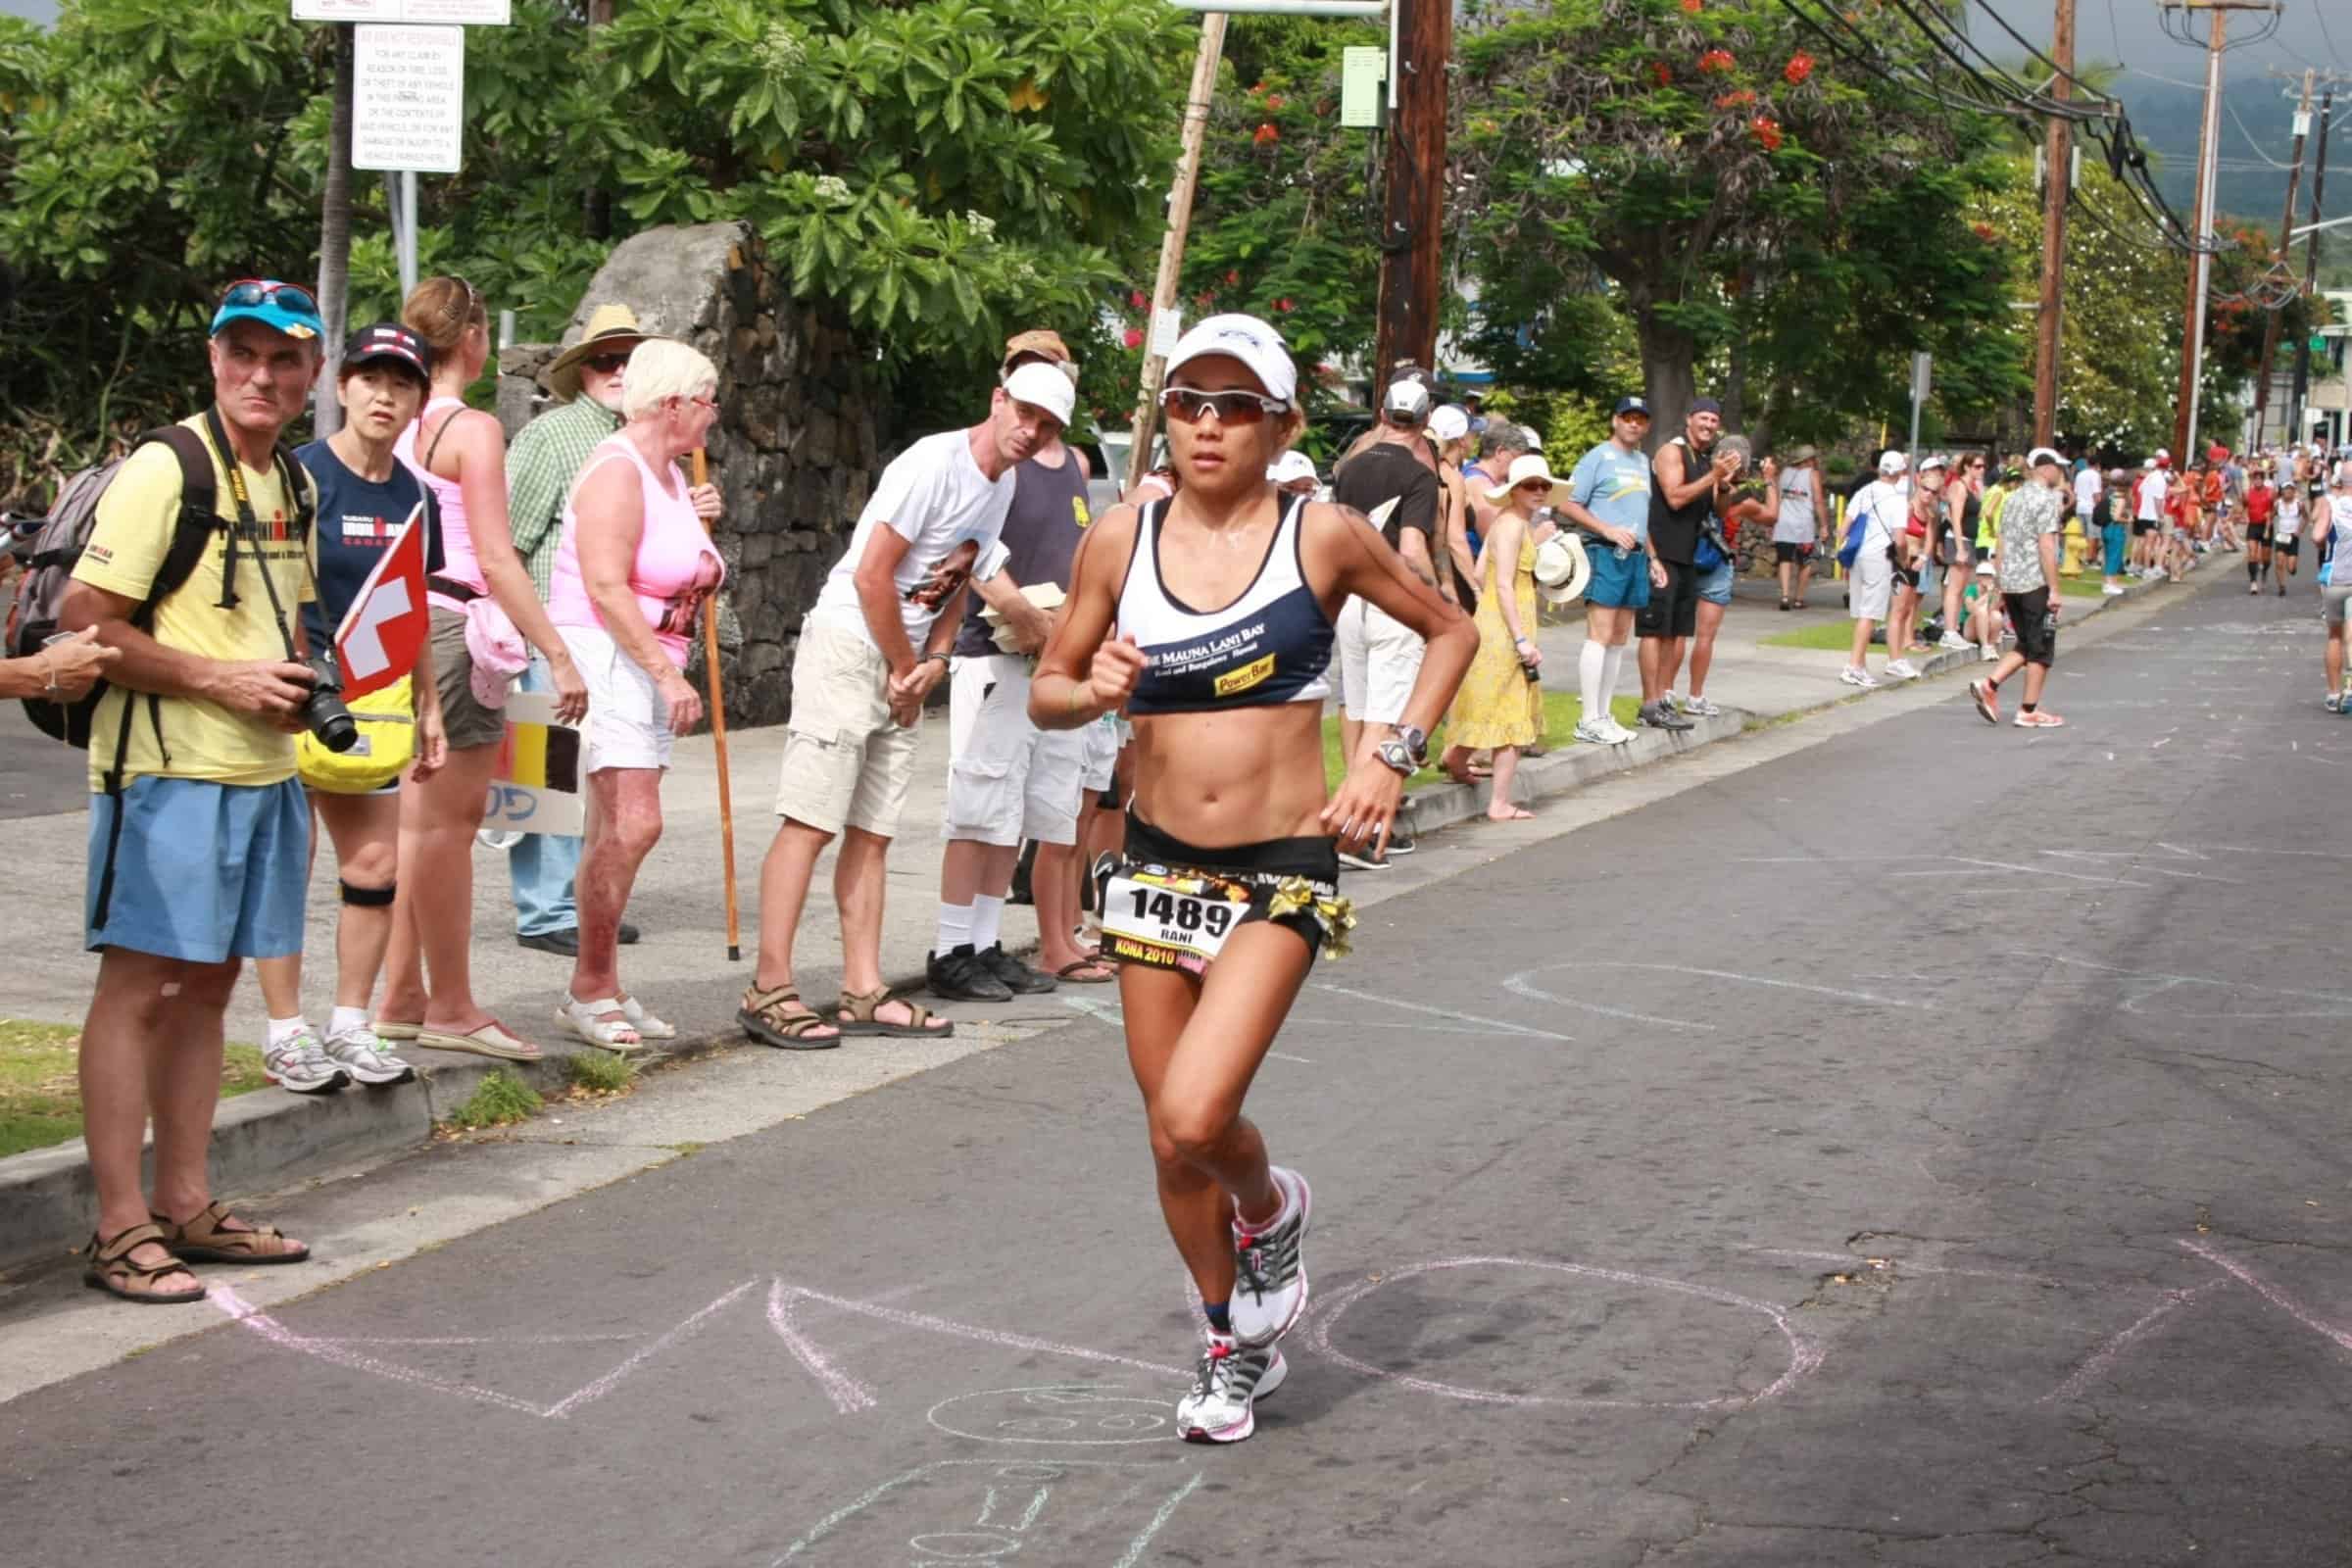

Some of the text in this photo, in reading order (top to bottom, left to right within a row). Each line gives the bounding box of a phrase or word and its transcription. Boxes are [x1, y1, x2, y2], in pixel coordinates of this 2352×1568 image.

[1163, 647, 1208, 665] MAUNA
[1210, 635, 1239, 653] LANI
[1241, 622, 1265, 639] BAY
[1129, 888, 1233, 938] 1489
[1115, 940, 1143, 959] KONA
[1144, 946, 1175, 964] 2010
[1160, 929, 1193, 944] RANI
